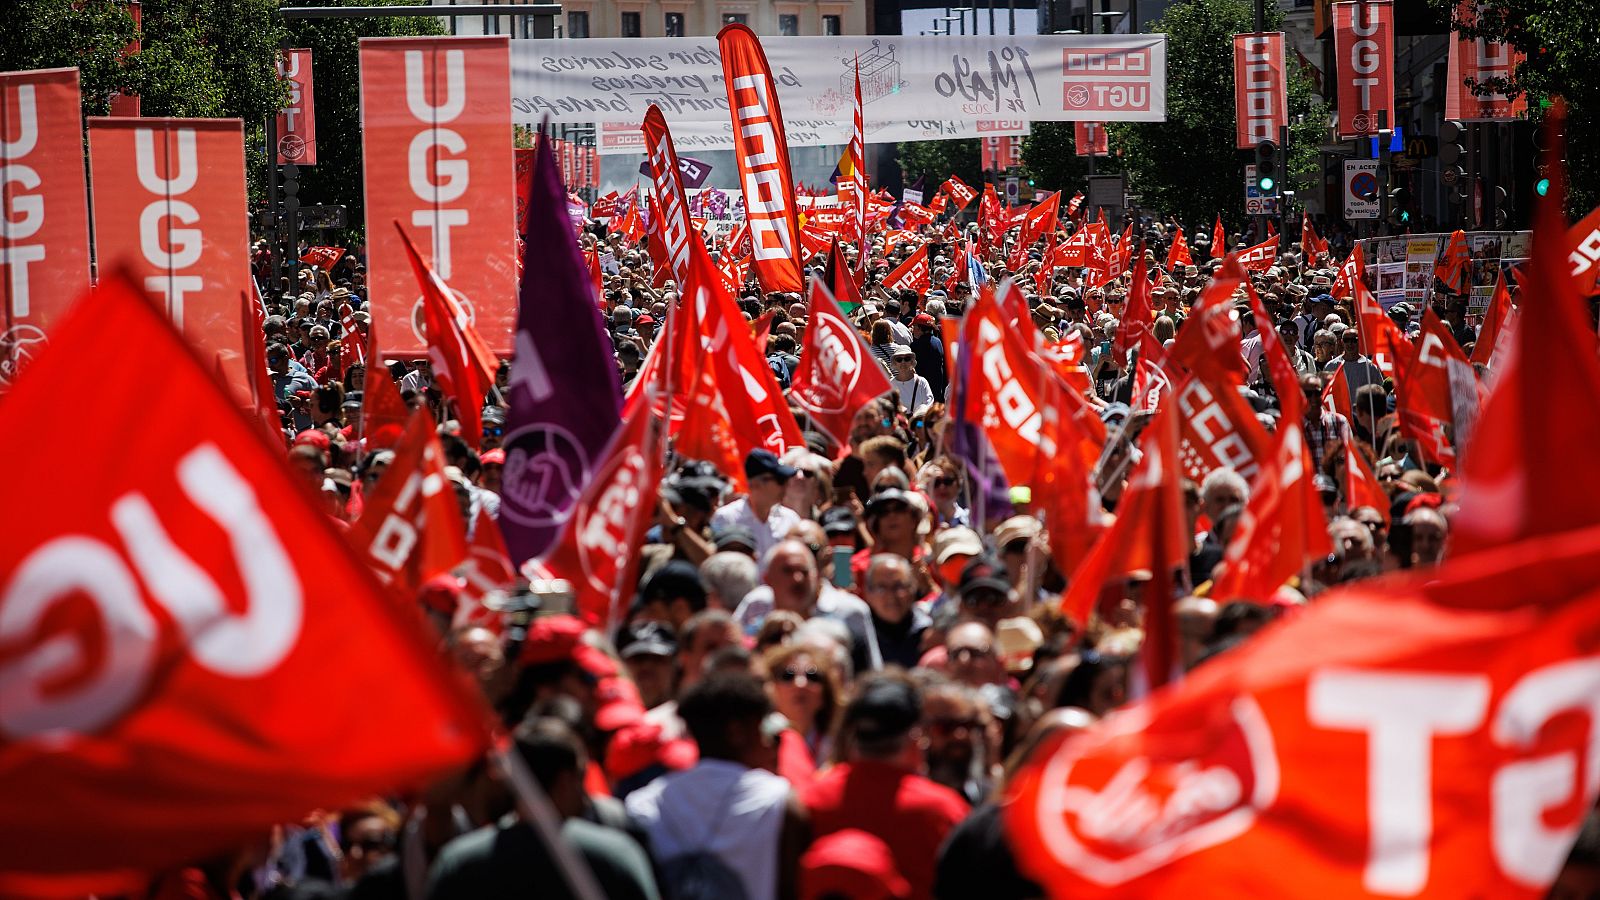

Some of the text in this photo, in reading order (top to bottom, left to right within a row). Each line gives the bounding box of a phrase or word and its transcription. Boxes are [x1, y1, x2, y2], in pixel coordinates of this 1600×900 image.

[1245, 37, 1272, 145] CCOO
[1351, 2, 1380, 111] UGT
[0, 84, 45, 318] UGT
[134, 128, 204, 340] UGT
[405, 49, 470, 281] UGT
[733, 73, 793, 262] CCOO
